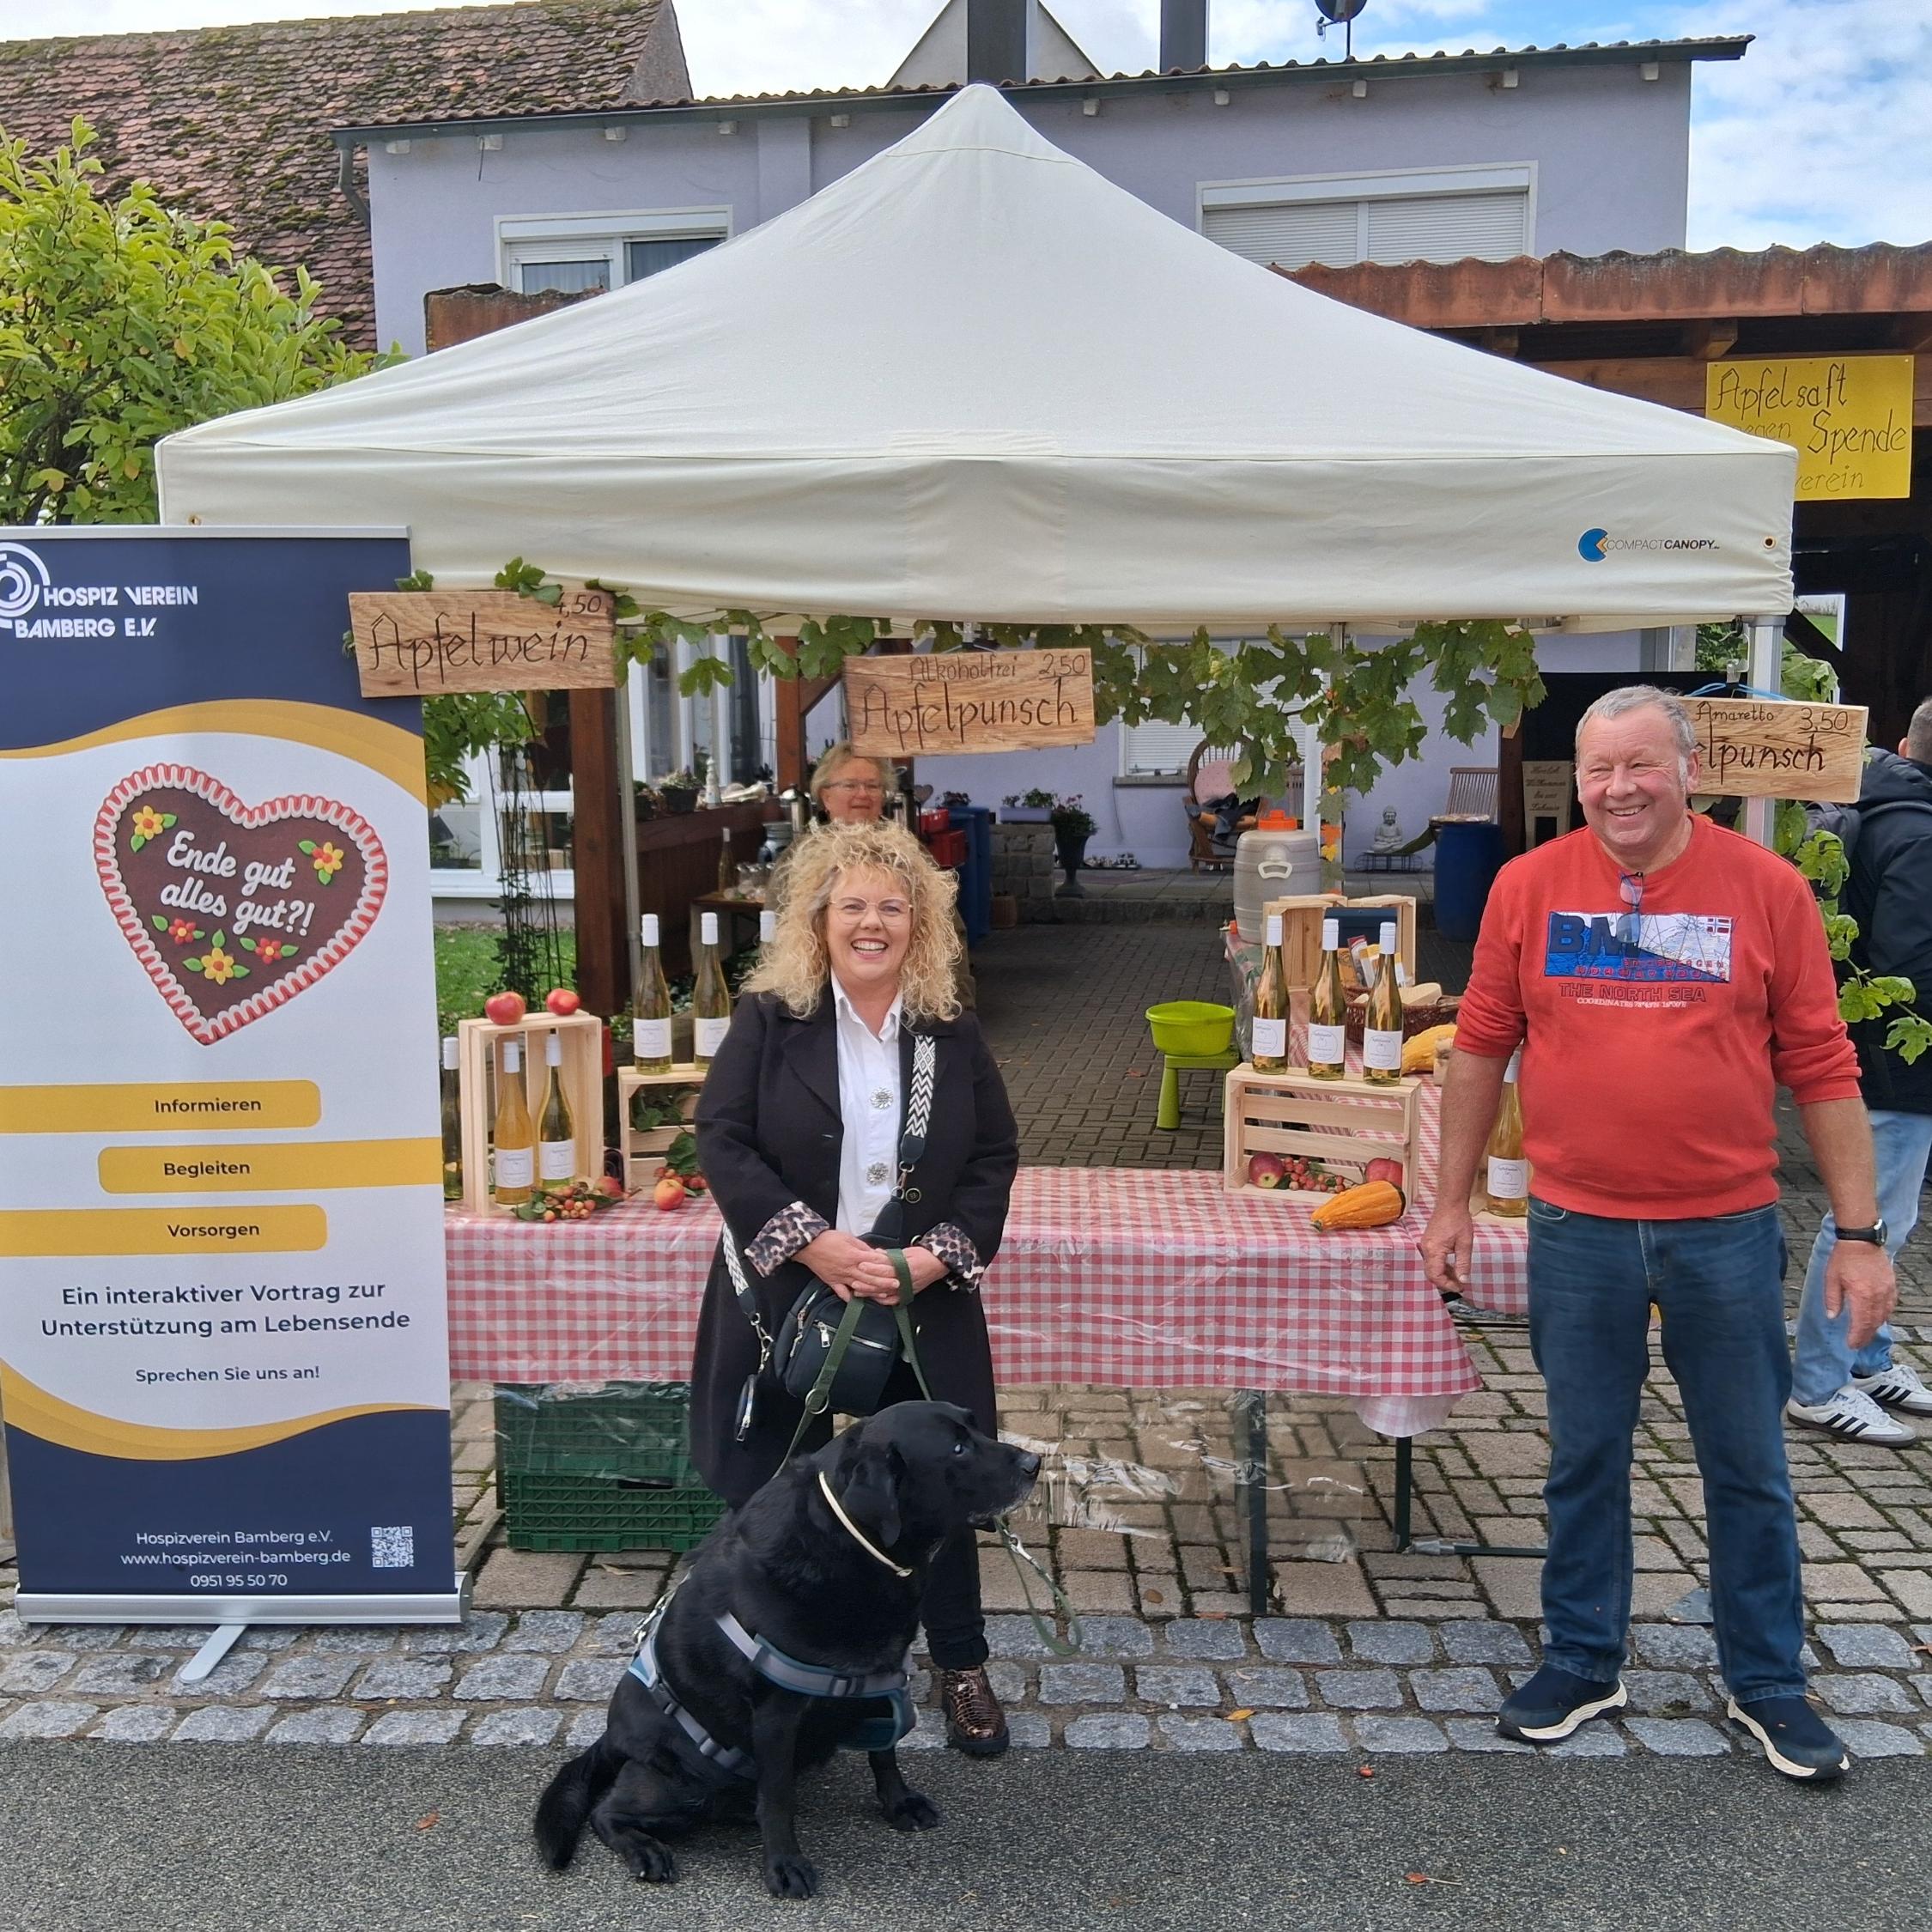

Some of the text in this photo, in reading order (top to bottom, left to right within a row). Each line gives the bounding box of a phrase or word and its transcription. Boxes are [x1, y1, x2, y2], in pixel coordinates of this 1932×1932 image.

[1712, 362, 1848, 421] Apfelsaft
[1733, 409, 1907, 465] egen Spende
[43, 586, 198, 607] HOSPIZ VEREIN
[15, 617, 115, 639] BAMBERG
[369, 611, 589, 690] Apfelwein
[908, 653, 1086, 684] Alkoholfrei 2,50
[858, 677, 1078, 752] Apfelpunsch
[1695, 701, 1849, 732] Amaretto 3,50
[167, 830, 296, 897] Ende gut
[160, 876, 315, 937] alles gut?!
[1558, 982, 1706, 1003] THE NORTH SEA
[155, 1097, 262, 1114] Informieren
[163, 1160, 251, 1178] Begleiten
[167, 1222, 260, 1240] Vorsorgen
[63, 1283, 386, 1305] Ein interaktiver Vortrag zur
[40, 1310, 410, 1339] Unterstützung am Lebensende
[136, 1366, 320, 1385] Sprechen Sie uns an!
[136, 1530, 333, 1547] Hospizverein Bamberg e.V.
[120, 1549, 351, 1566] www.hospizverein-bamberg.de
[190, 1573, 288, 1588] 0951 95 50 70
